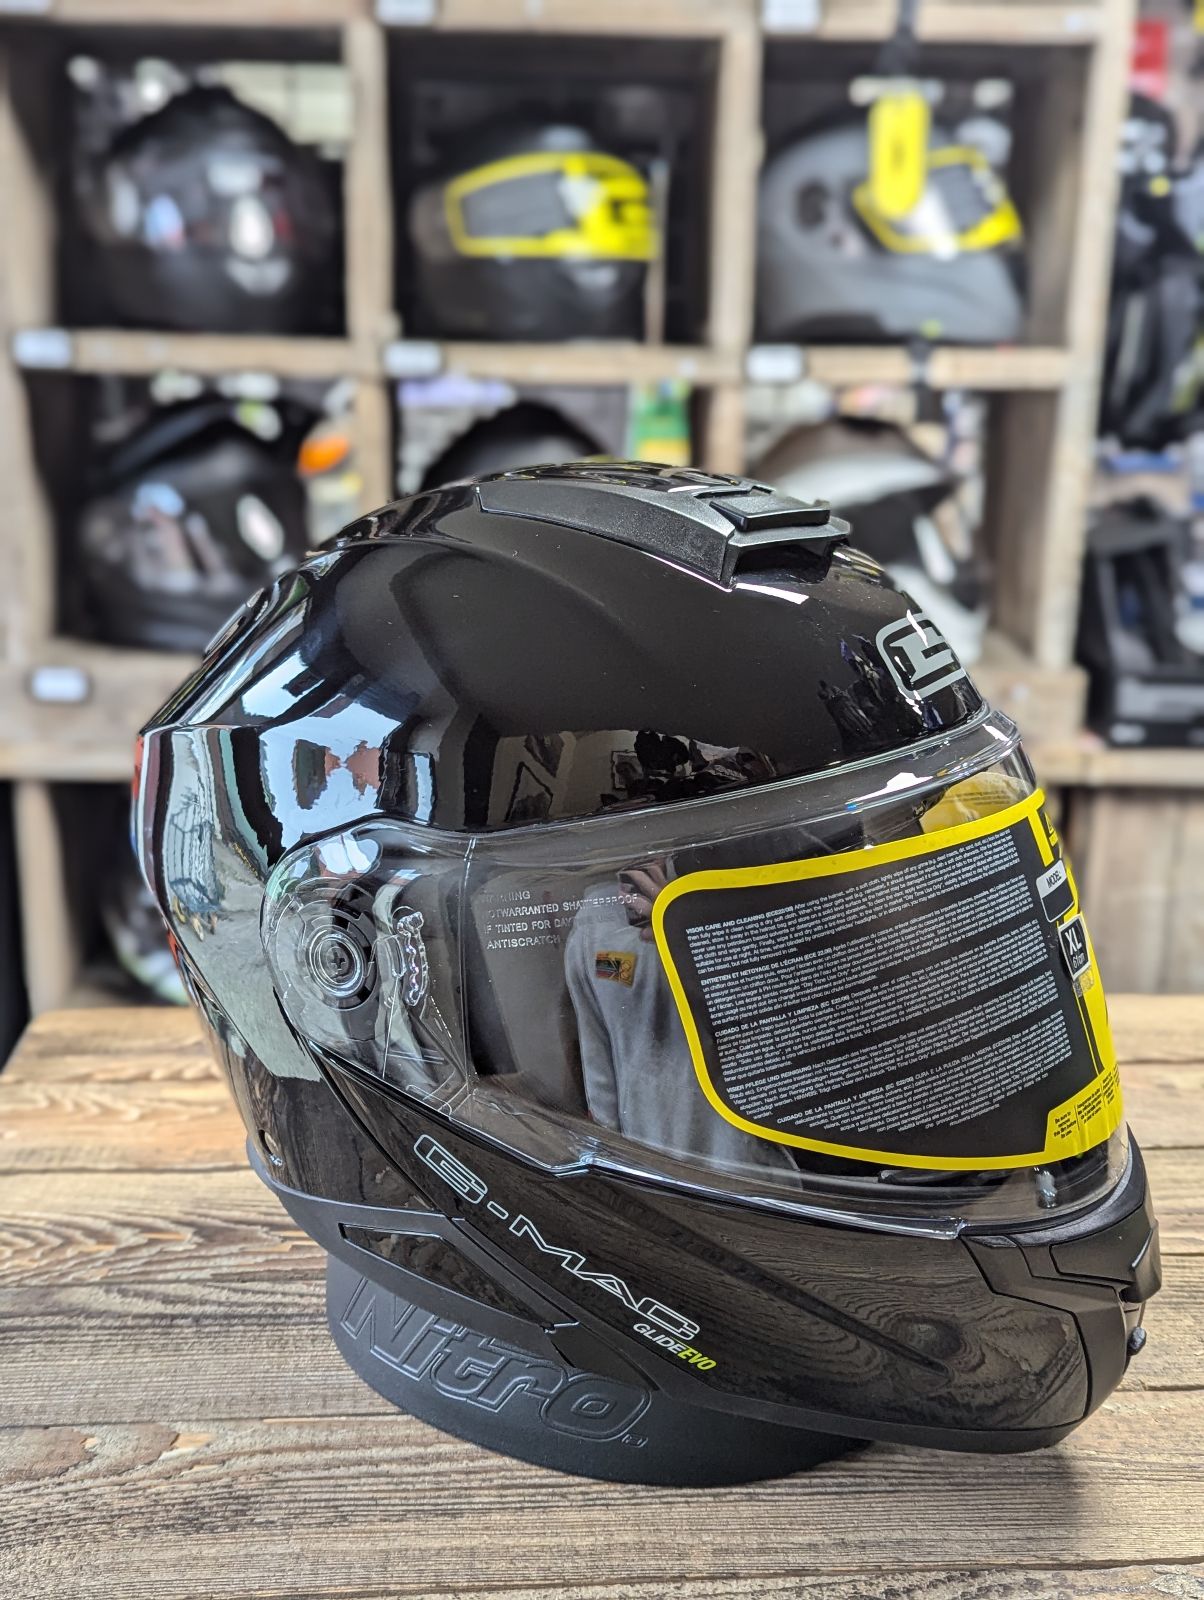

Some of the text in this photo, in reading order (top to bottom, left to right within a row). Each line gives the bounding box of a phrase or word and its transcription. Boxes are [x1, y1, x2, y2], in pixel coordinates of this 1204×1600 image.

[495, 922, 528, 934] TINTED
[531, 919, 551, 930] FOR
[736, 914, 765, 924] CLEANING
[486, 934, 560, 950] ANTISCRATCH
[1064, 926, 1082, 956] XL
[715, 1026, 739, 1036] CUIDADO
[759, 1014, 786, 1026] PANTALLA
[777, 1113, 803, 1124] CUIDADO
[824, 1097, 851, 1110] PANTALLA
